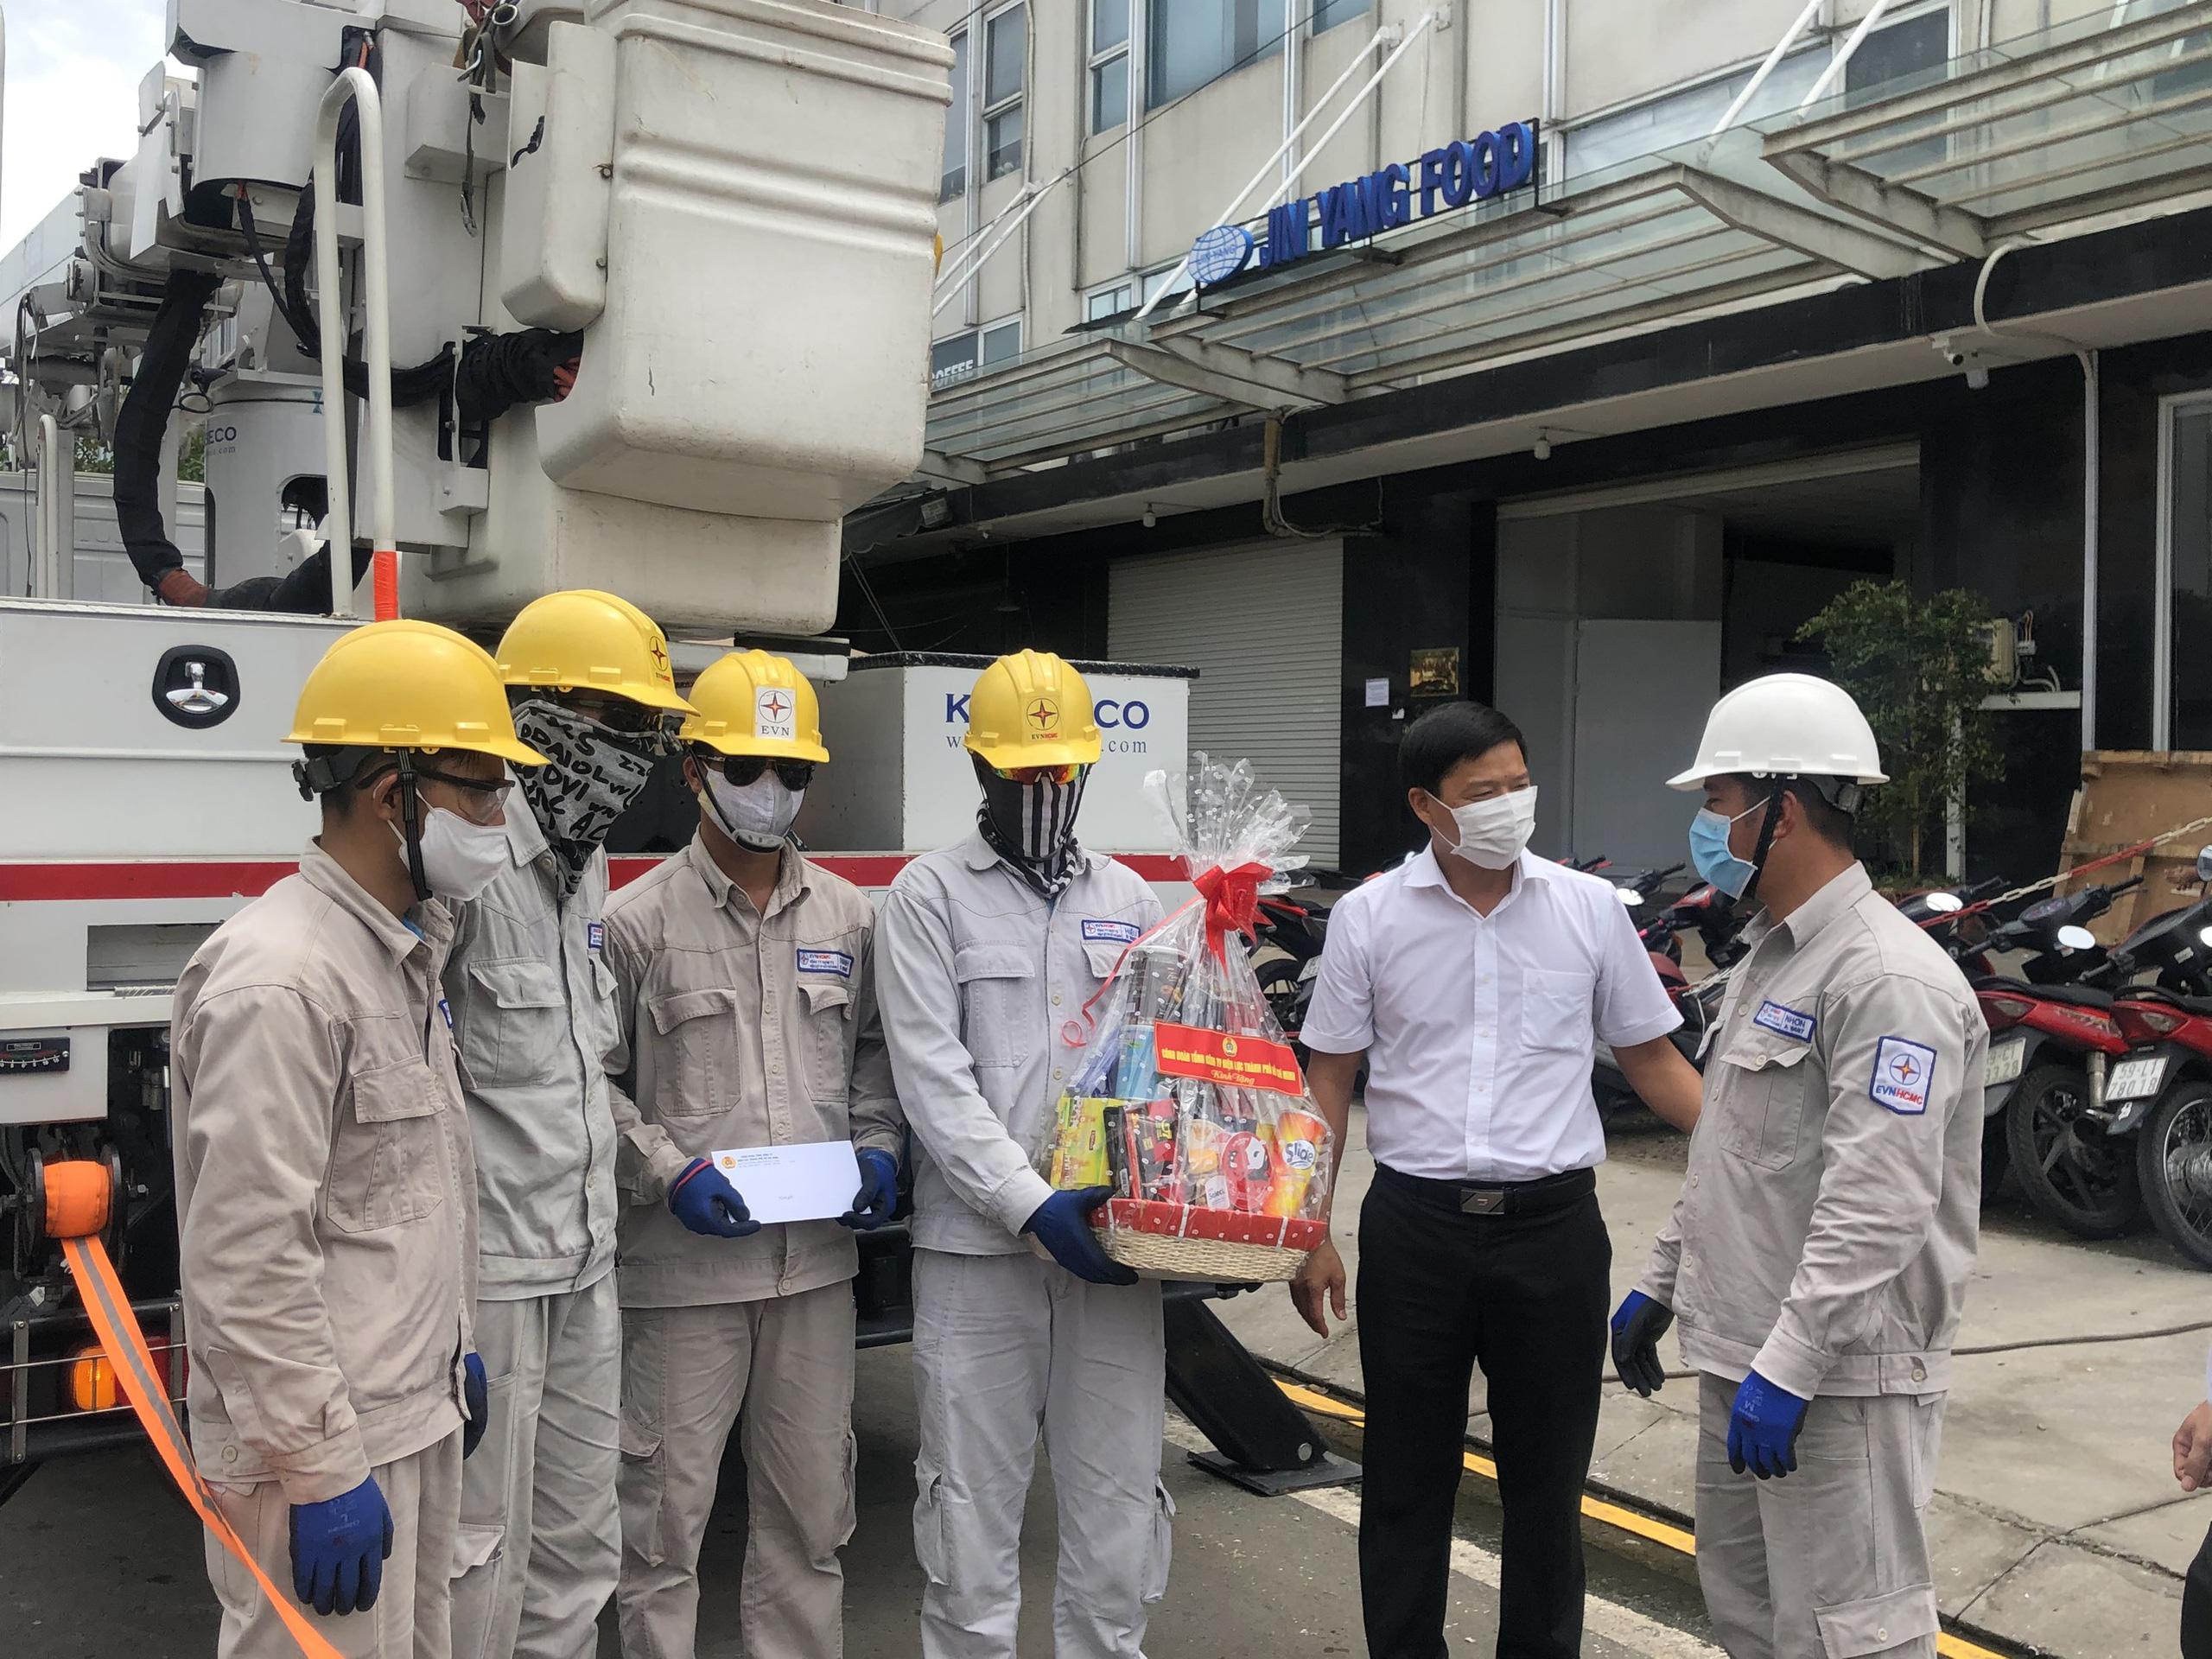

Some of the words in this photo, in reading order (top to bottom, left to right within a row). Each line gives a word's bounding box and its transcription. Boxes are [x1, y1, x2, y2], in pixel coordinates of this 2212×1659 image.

[1260, 199, 1309, 269] JIN
[1318, 163, 1411, 249] YANG
[1421, 121, 1535, 217] FOOD
[931, 359, 974, 388] OFFEE
[760, 725, 791, 737] EVN
[1875, 1084, 1923, 1105] EVNHCMC
